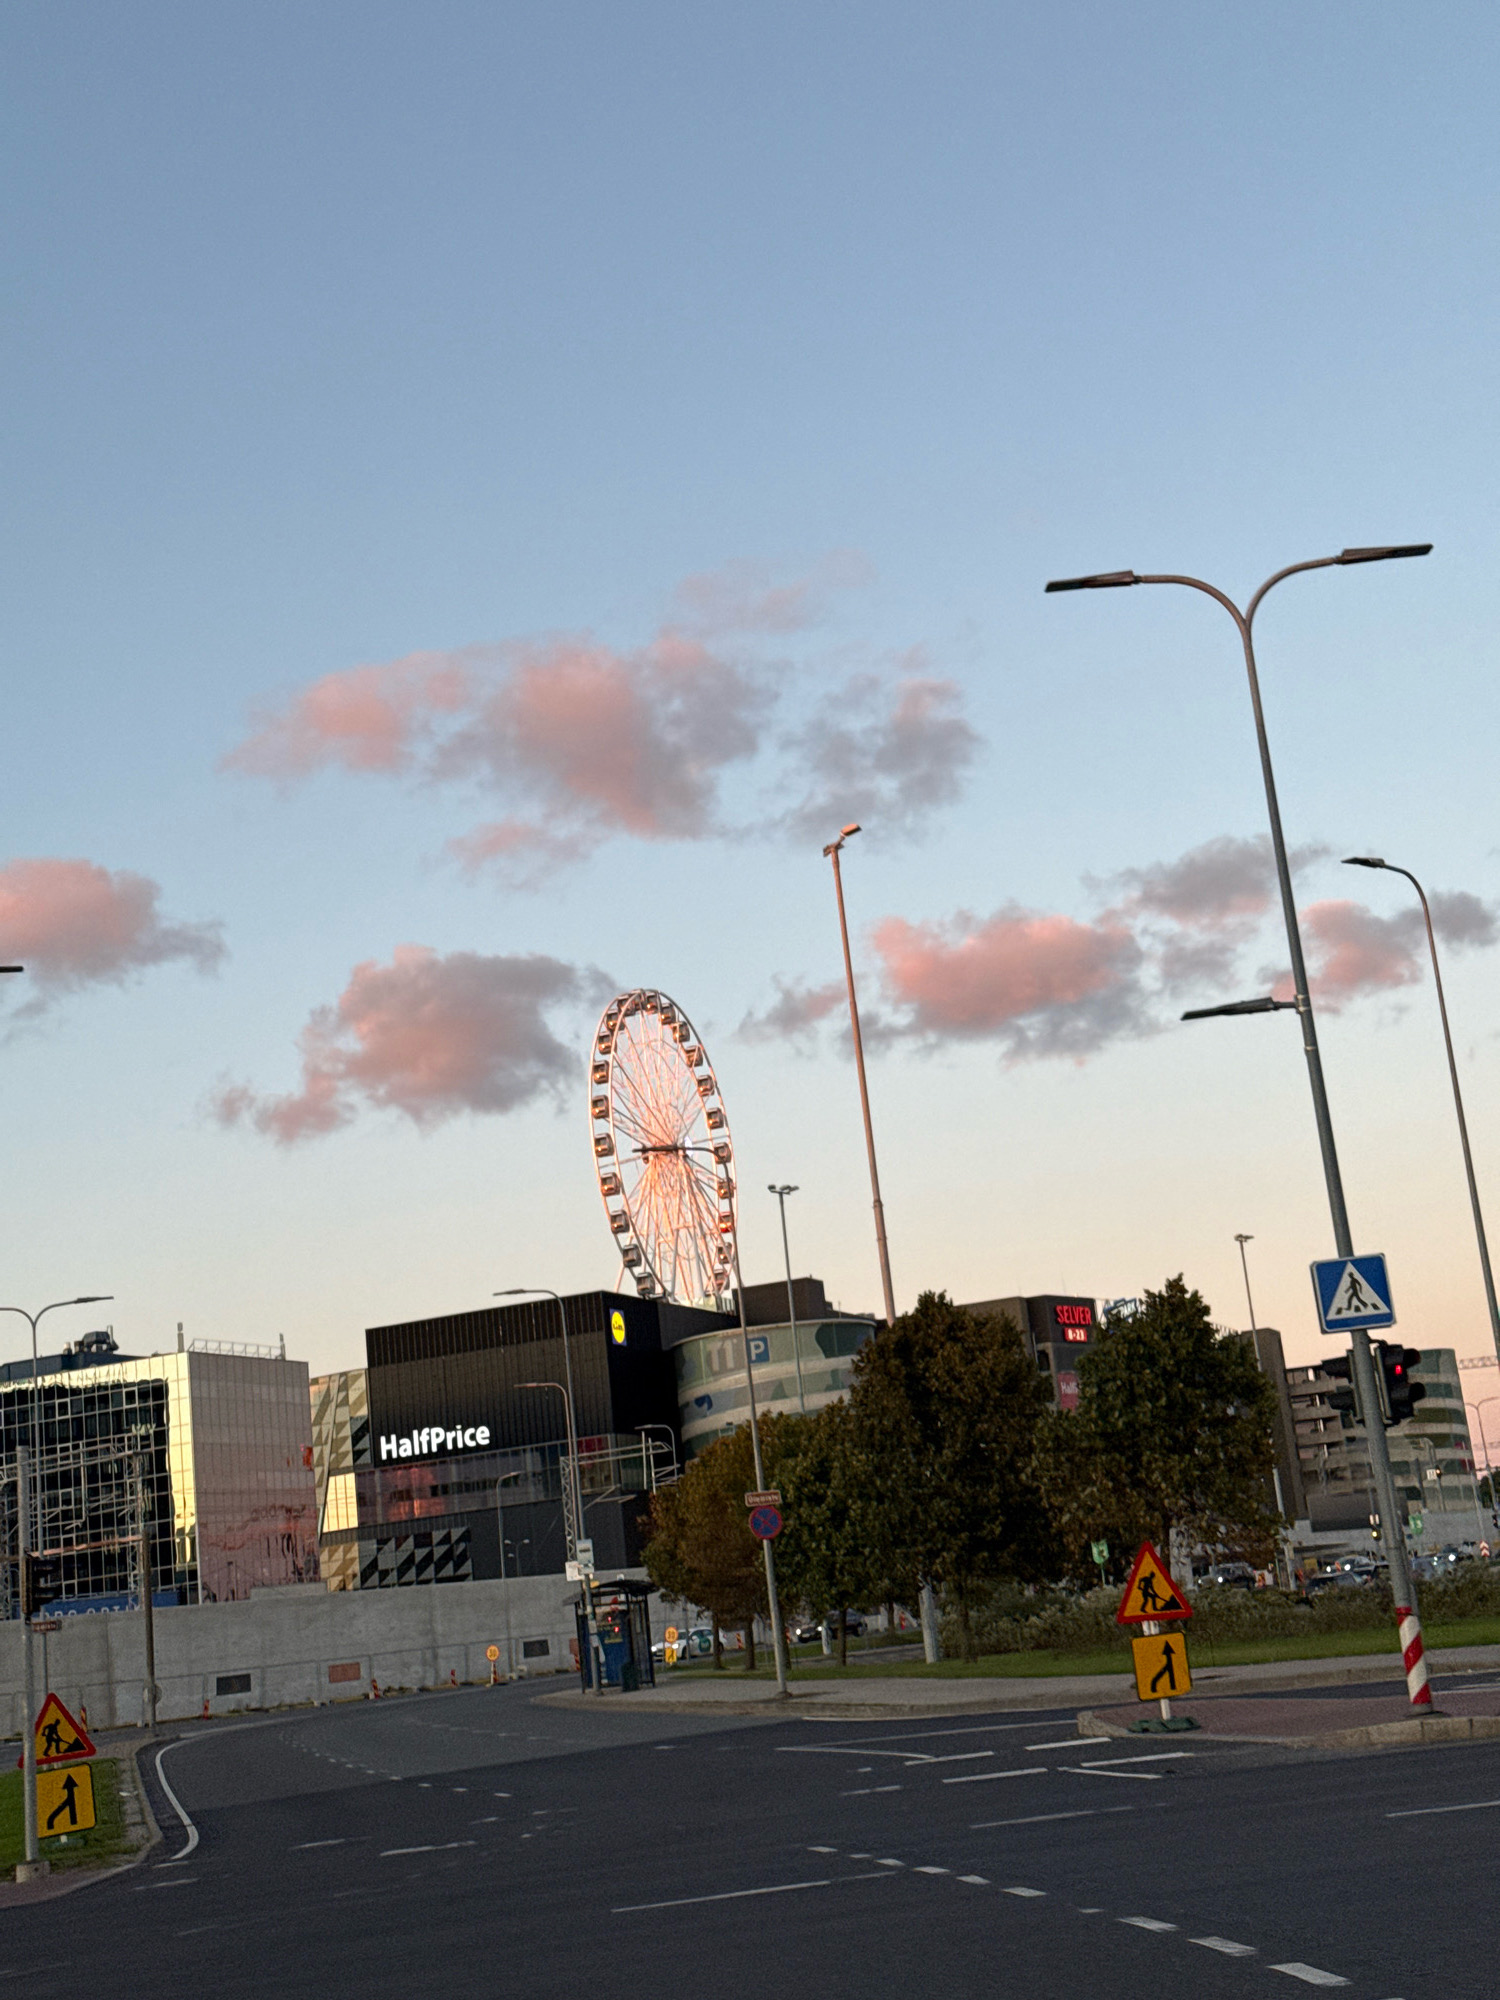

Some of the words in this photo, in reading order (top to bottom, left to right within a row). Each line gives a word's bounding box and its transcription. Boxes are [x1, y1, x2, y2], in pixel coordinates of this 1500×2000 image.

[1056, 1305, 1091, 1325] SELVER
[749, 1340, 765, 1361] P
[380, 1425, 490, 1460] HalfPrice
